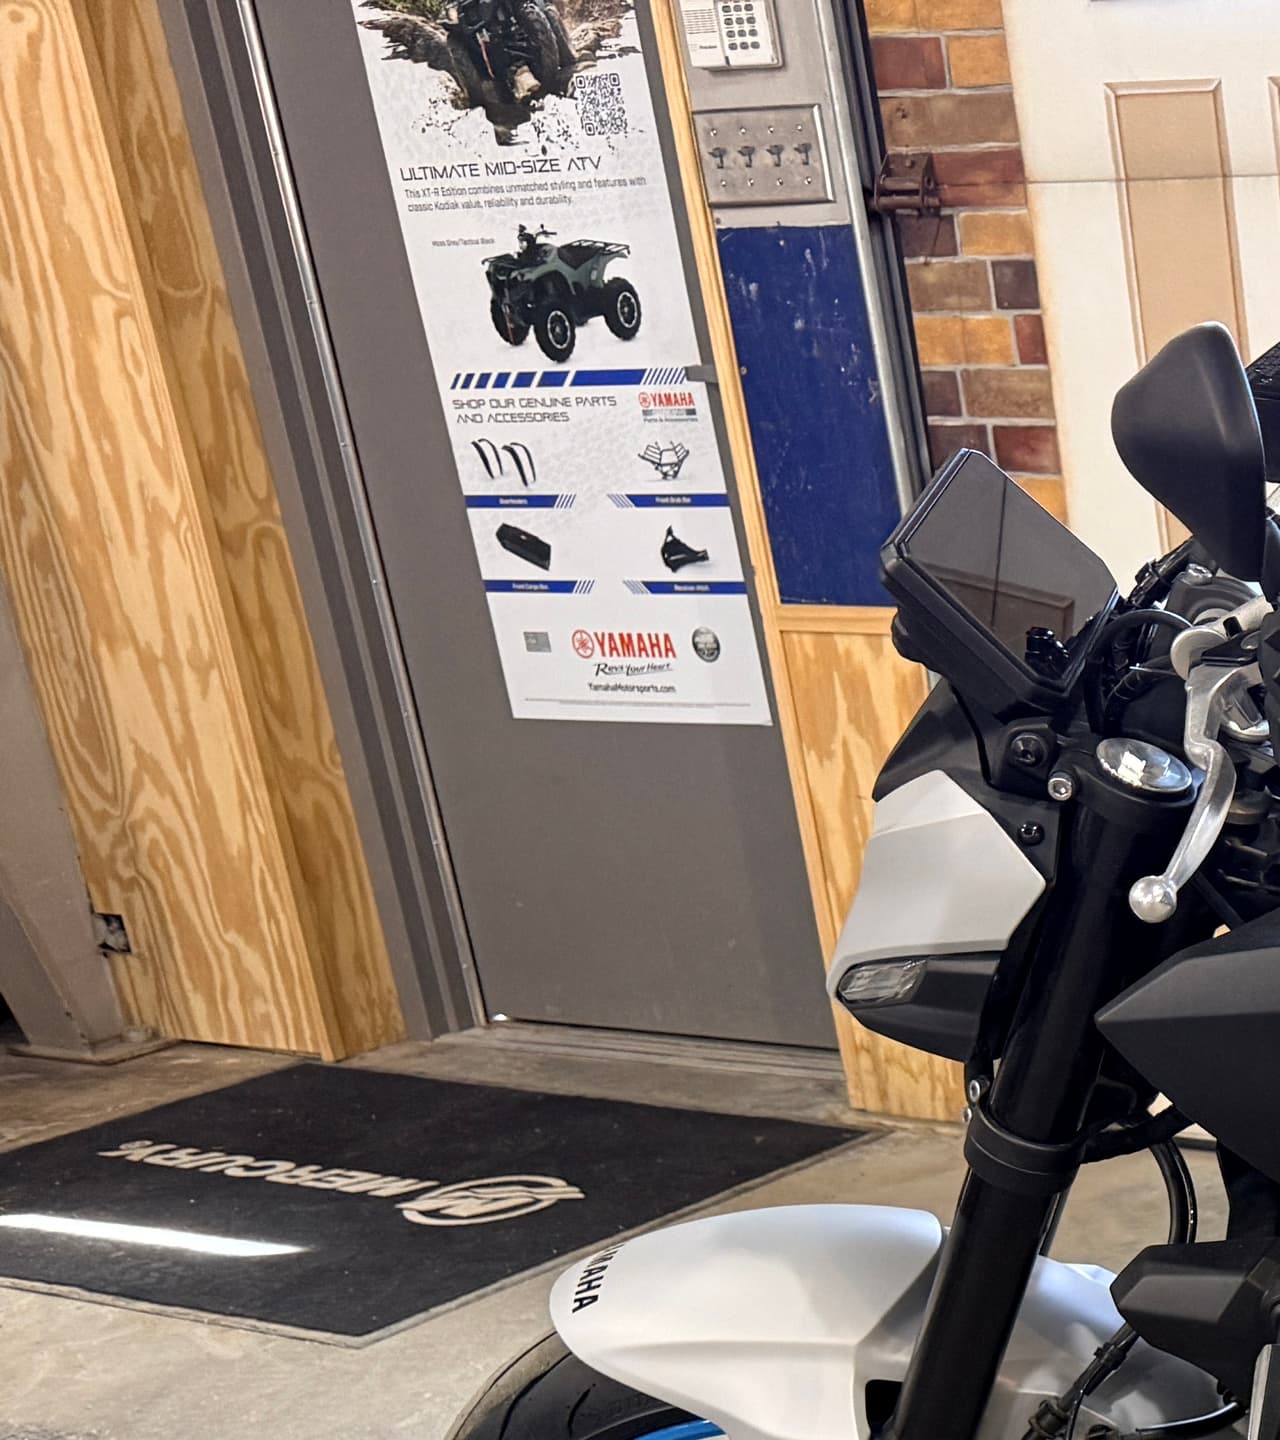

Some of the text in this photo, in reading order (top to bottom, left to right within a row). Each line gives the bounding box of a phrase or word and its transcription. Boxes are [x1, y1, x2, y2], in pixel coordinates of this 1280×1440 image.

[400, 155, 602, 181] ULTIMATE MID-SIZE ATV
[404, 188, 421, 198] This
[441, 186, 467, 197] Edition
[468, 184, 505, 195] combines
[550, 180, 577, 192] styling
[577, 179, 593, 189] and
[452, 396, 617, 410] SHOP OUR GENUINE PARTS
[650, 391, 697, 407] YAMAHA
[457, 412, 570, 424] AND ACCESSORIES
[593, 632, 677, 659] YAMAHA
